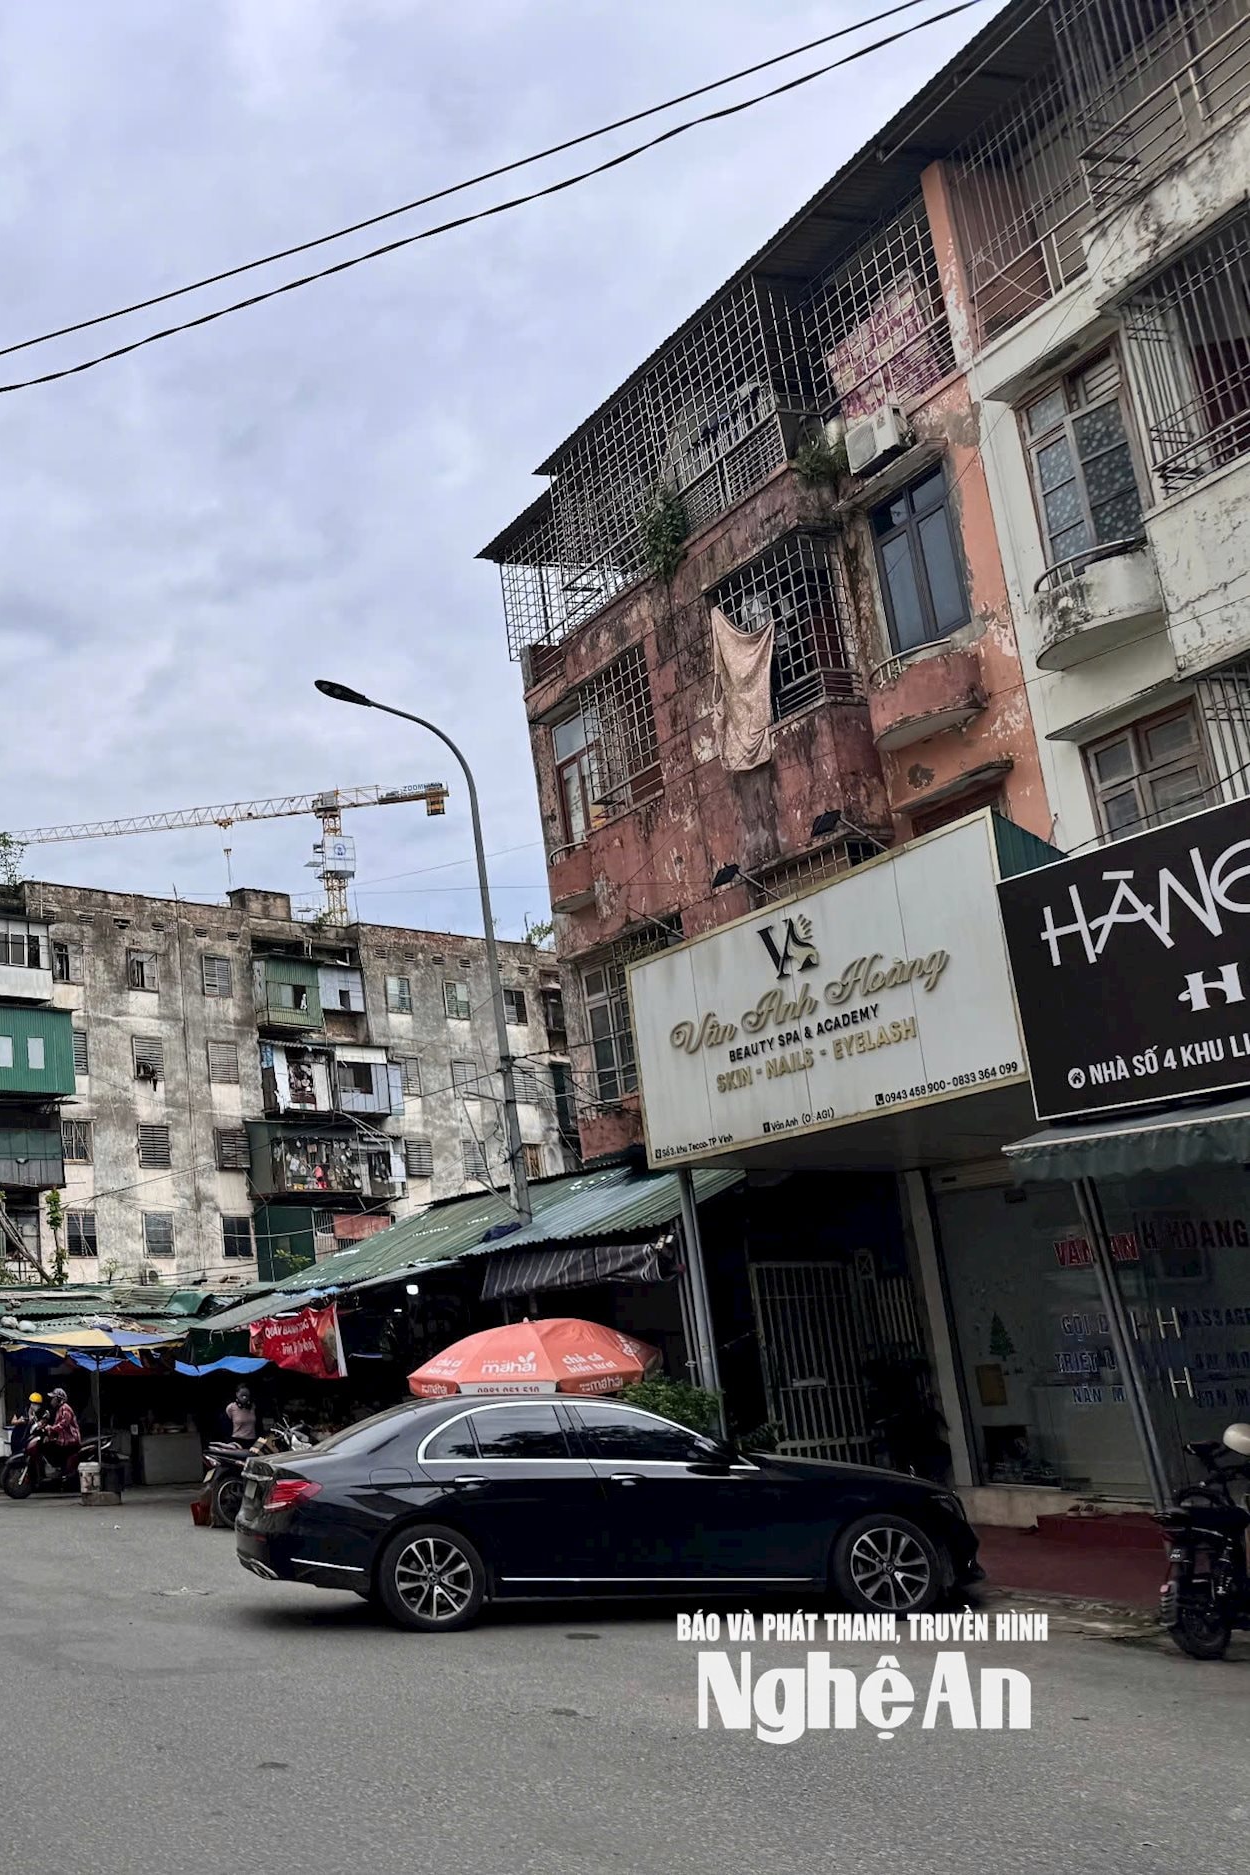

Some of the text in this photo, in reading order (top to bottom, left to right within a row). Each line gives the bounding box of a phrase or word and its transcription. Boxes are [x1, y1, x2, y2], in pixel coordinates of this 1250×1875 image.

[670, 949, 951, 1054] Vân Anh Hoàng
[716, 1066, 753, 1093] SKIN
[766, 1047, 814, 1079] NAILS
[832, 1016, 918, 1060] EYELASH
[729, 1003, 880, 1062] BEAUTY SPA & ACADEMY
[1088, 1054, 1130, 1086] NHÀ
[1133, 1044, 1160, 1076] SỐ
[1163, 1047, 1178, 1071] 4
[1181, 1038, 1225, 1067] KHU
[885, 1090, 909, 1104] 0943
[909, 1084, 927, 1098] 458
[978, 1066, 998, 1080] 364
[998, 1061, 1018, 1076] 099
